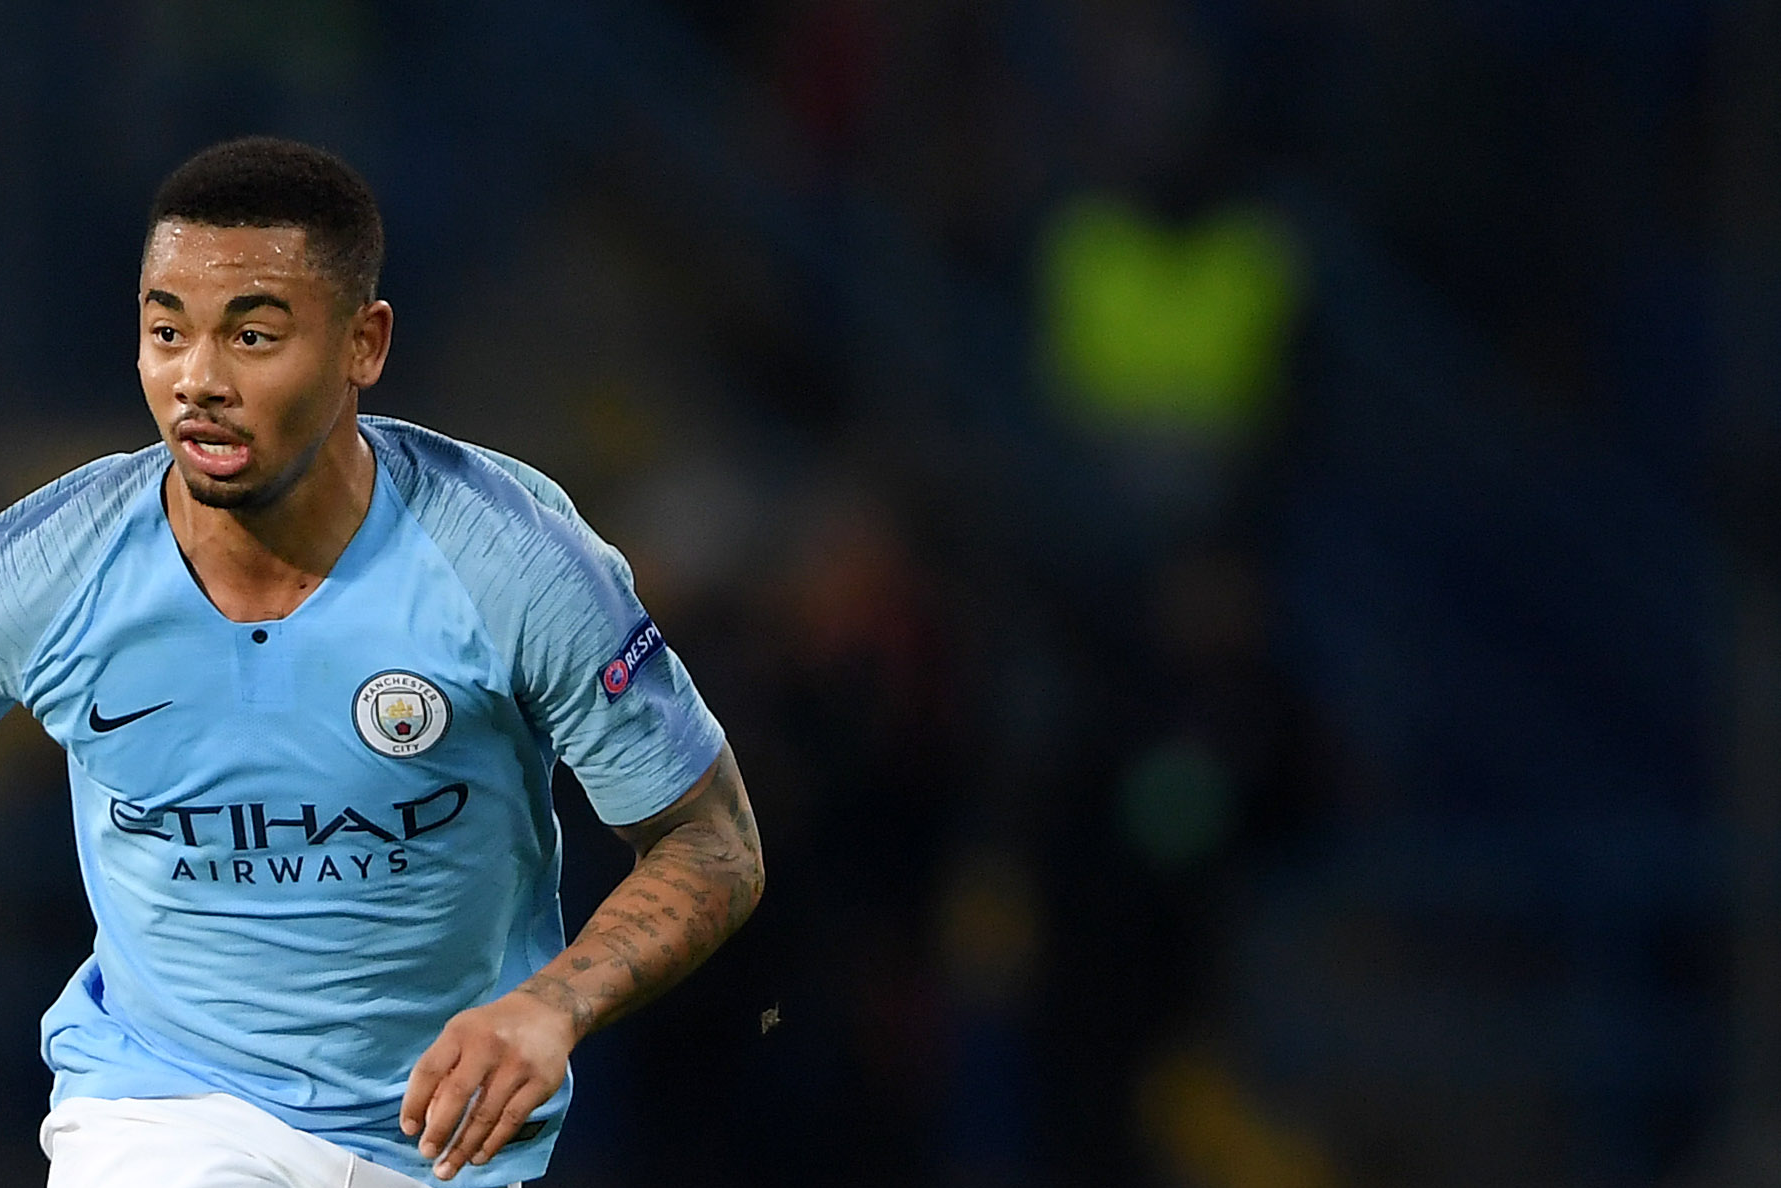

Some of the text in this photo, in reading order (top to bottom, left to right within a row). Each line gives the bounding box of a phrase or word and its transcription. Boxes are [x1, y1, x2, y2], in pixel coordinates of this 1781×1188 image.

[624, 621, 662, 671] RESP
[362, 678, 438, 702] MANCHESTER
[392, 743, 419, 753] CITY
[110, 783, 469, 850] ETIHAD
[172, 849, 408, 884] AIRWAYS
